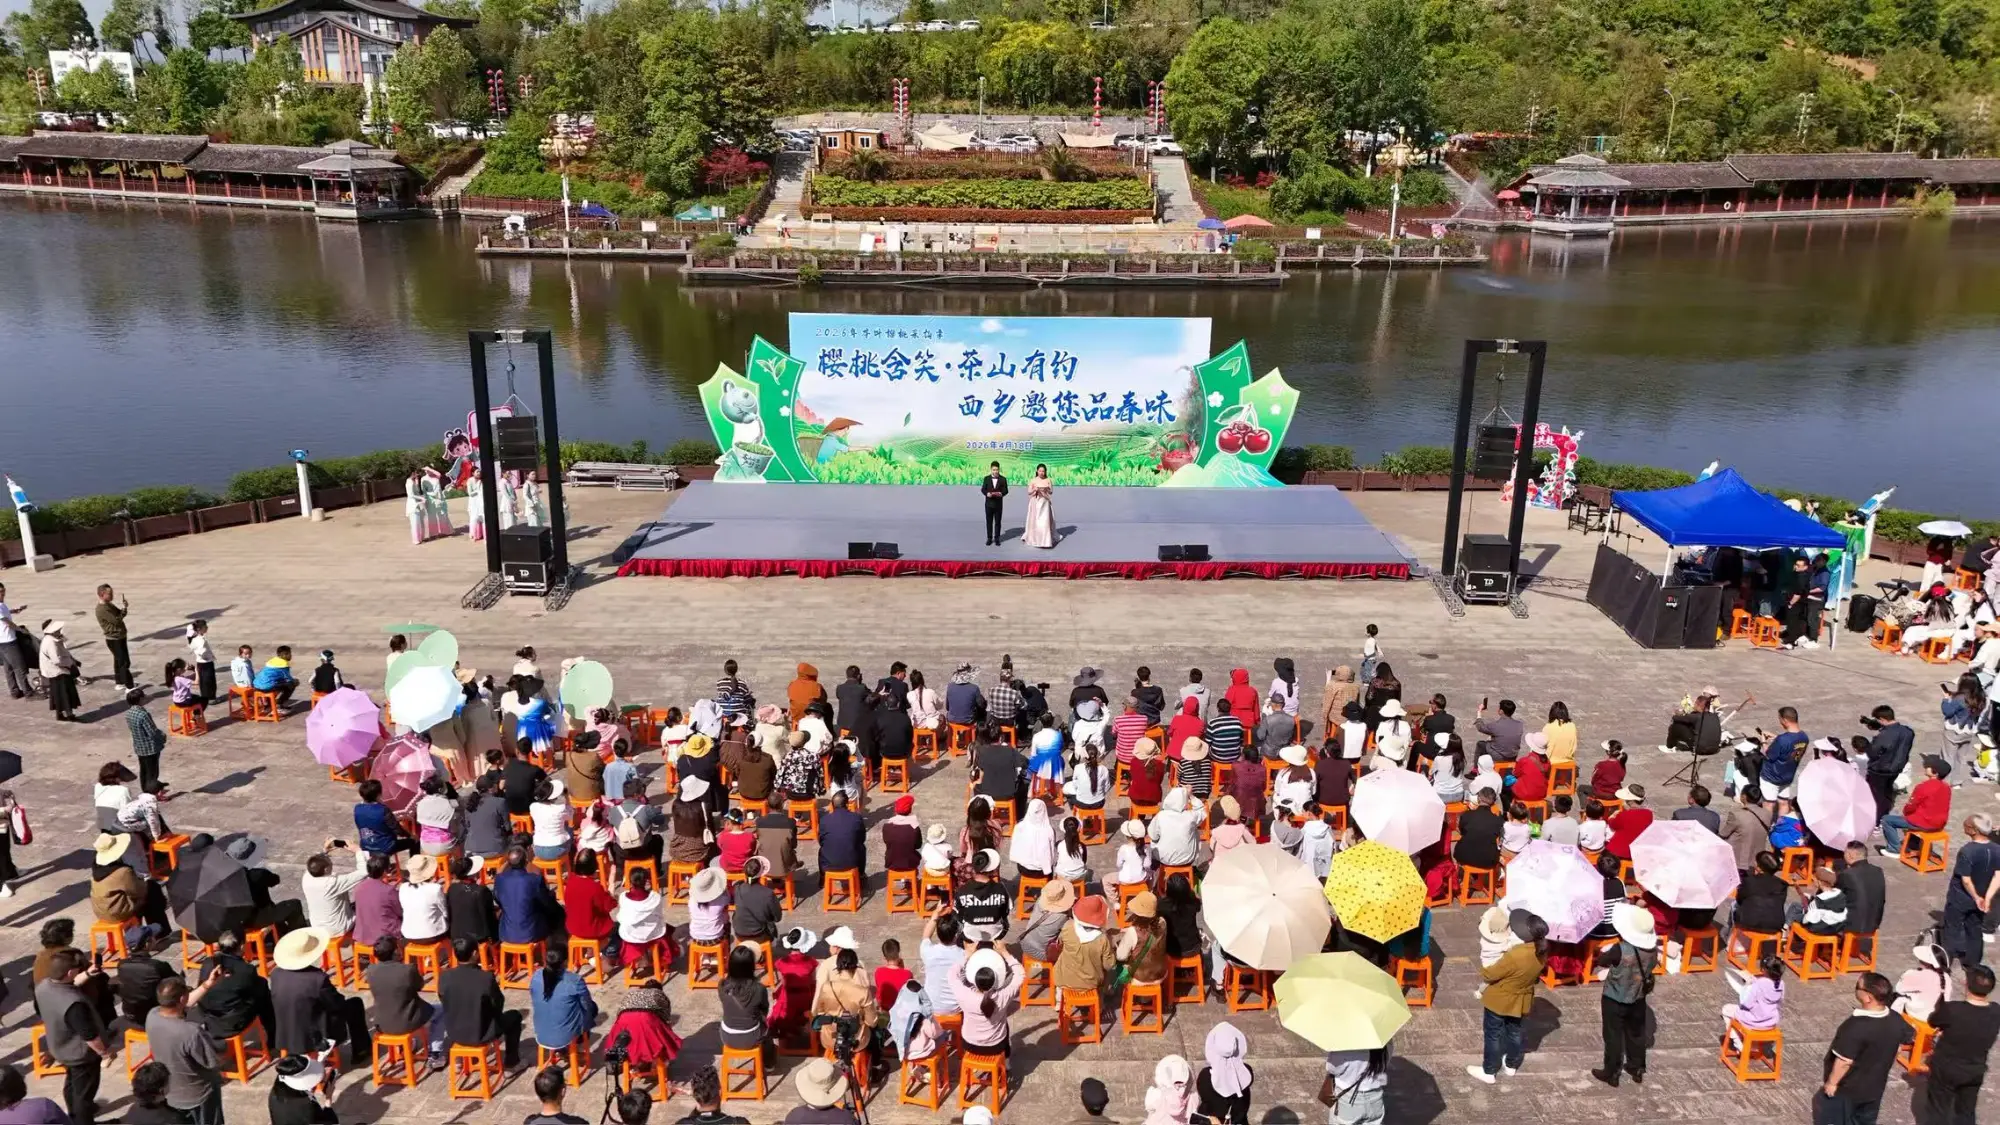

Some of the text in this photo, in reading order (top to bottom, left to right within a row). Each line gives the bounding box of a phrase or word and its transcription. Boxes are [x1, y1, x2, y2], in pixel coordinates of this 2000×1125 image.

[818, 347, 1078, 382] 樱桃含笑·茶山有约
[958, 389, 1176, 424] 西乡邀您品春味
[966, 441, 1032, 449] 2026年4月18日
